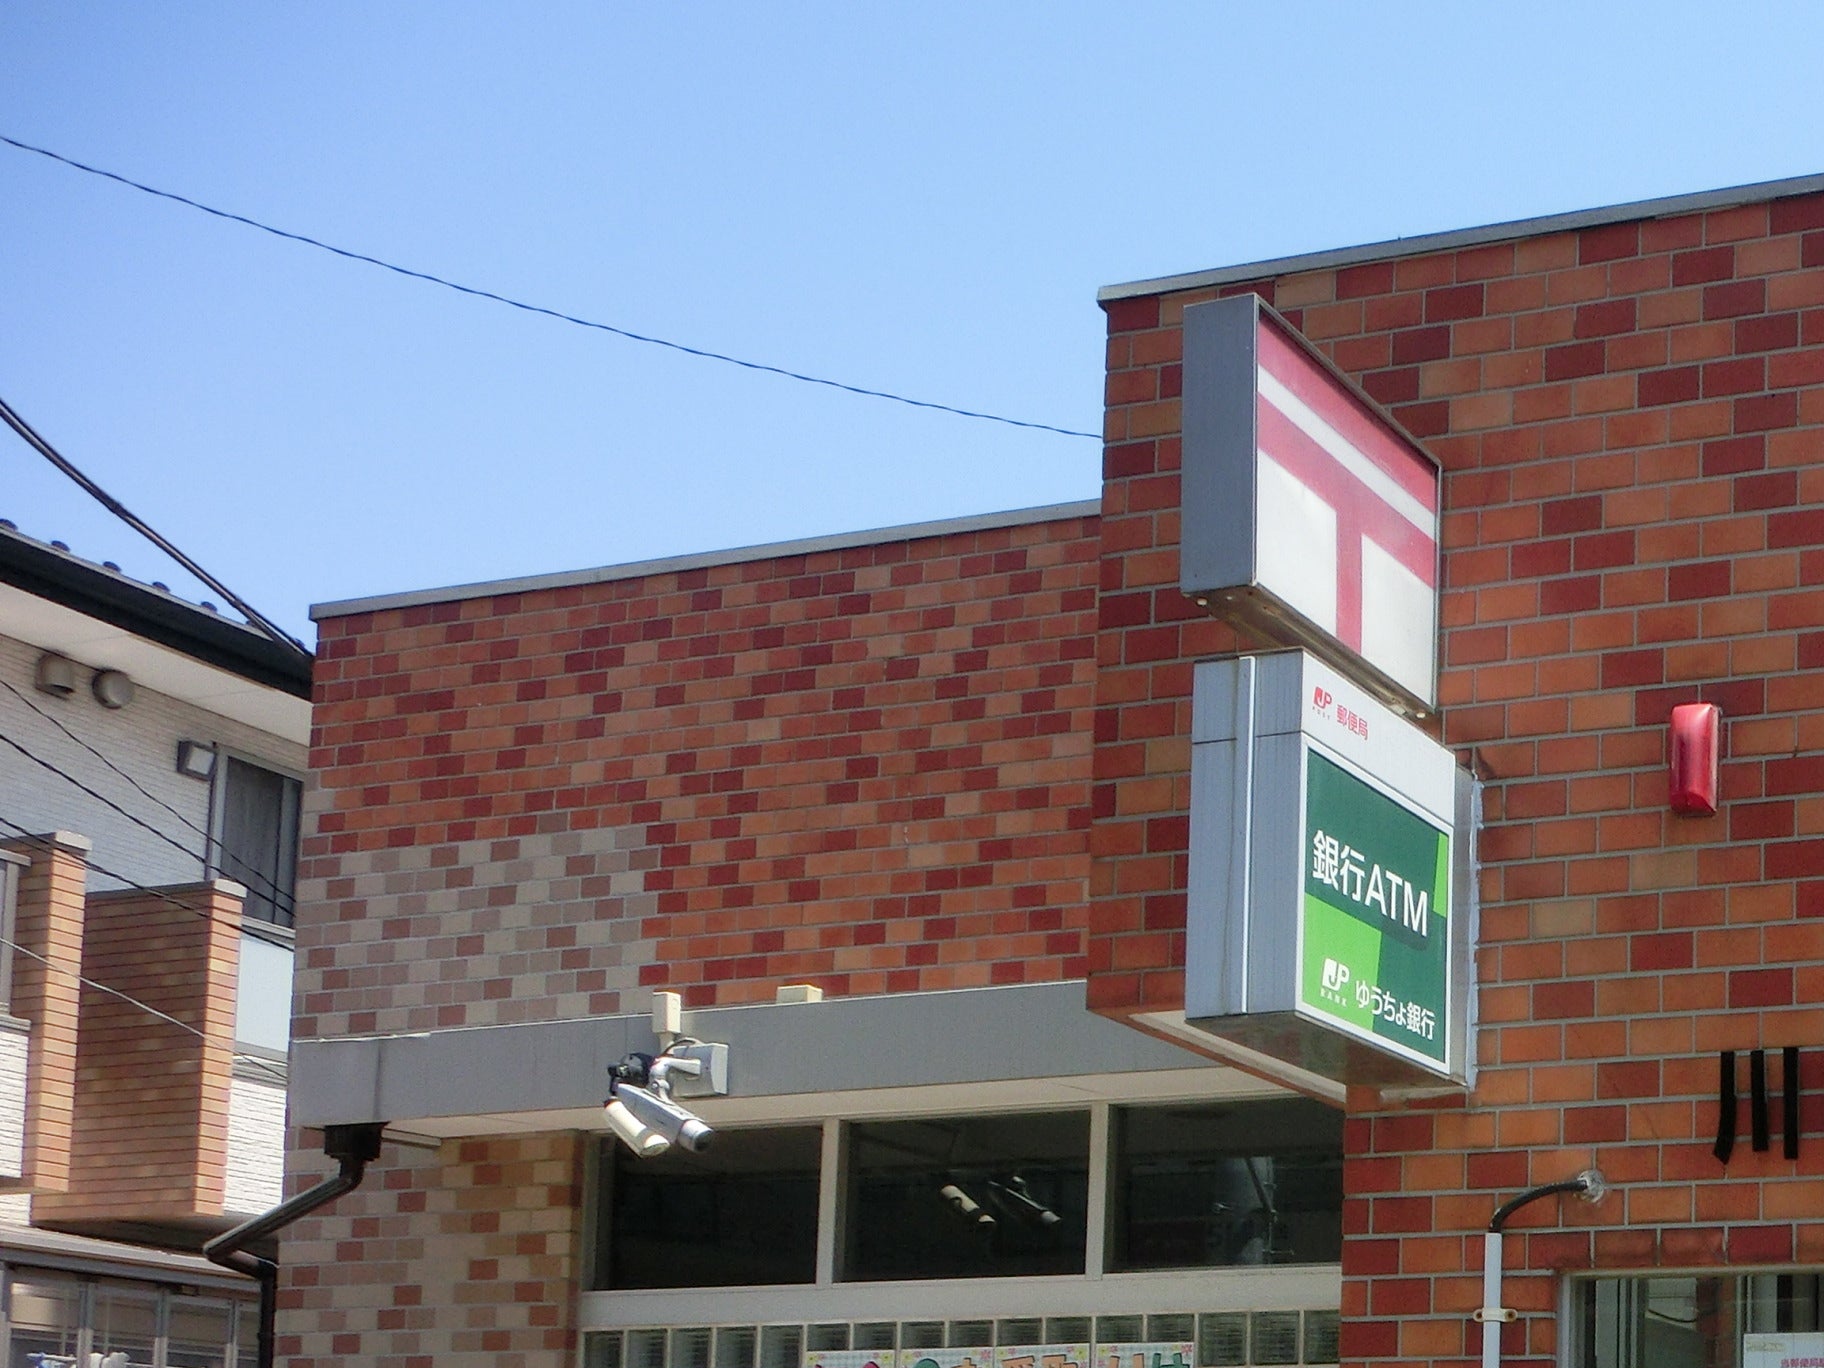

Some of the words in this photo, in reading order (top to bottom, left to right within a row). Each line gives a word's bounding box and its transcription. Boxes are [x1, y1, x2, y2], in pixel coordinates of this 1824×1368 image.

[1313, 686, 1333, 711] JP
[1336, 704, 1370, 741] 郵便局
[1312, 829, 1429, 938] 銀行ATM
[1319, 989, 1348, 1009] BANK
[1321, 957, 1350, 992] JP
[1354, 979, 1436, 1042] ゆうちょ銀行
